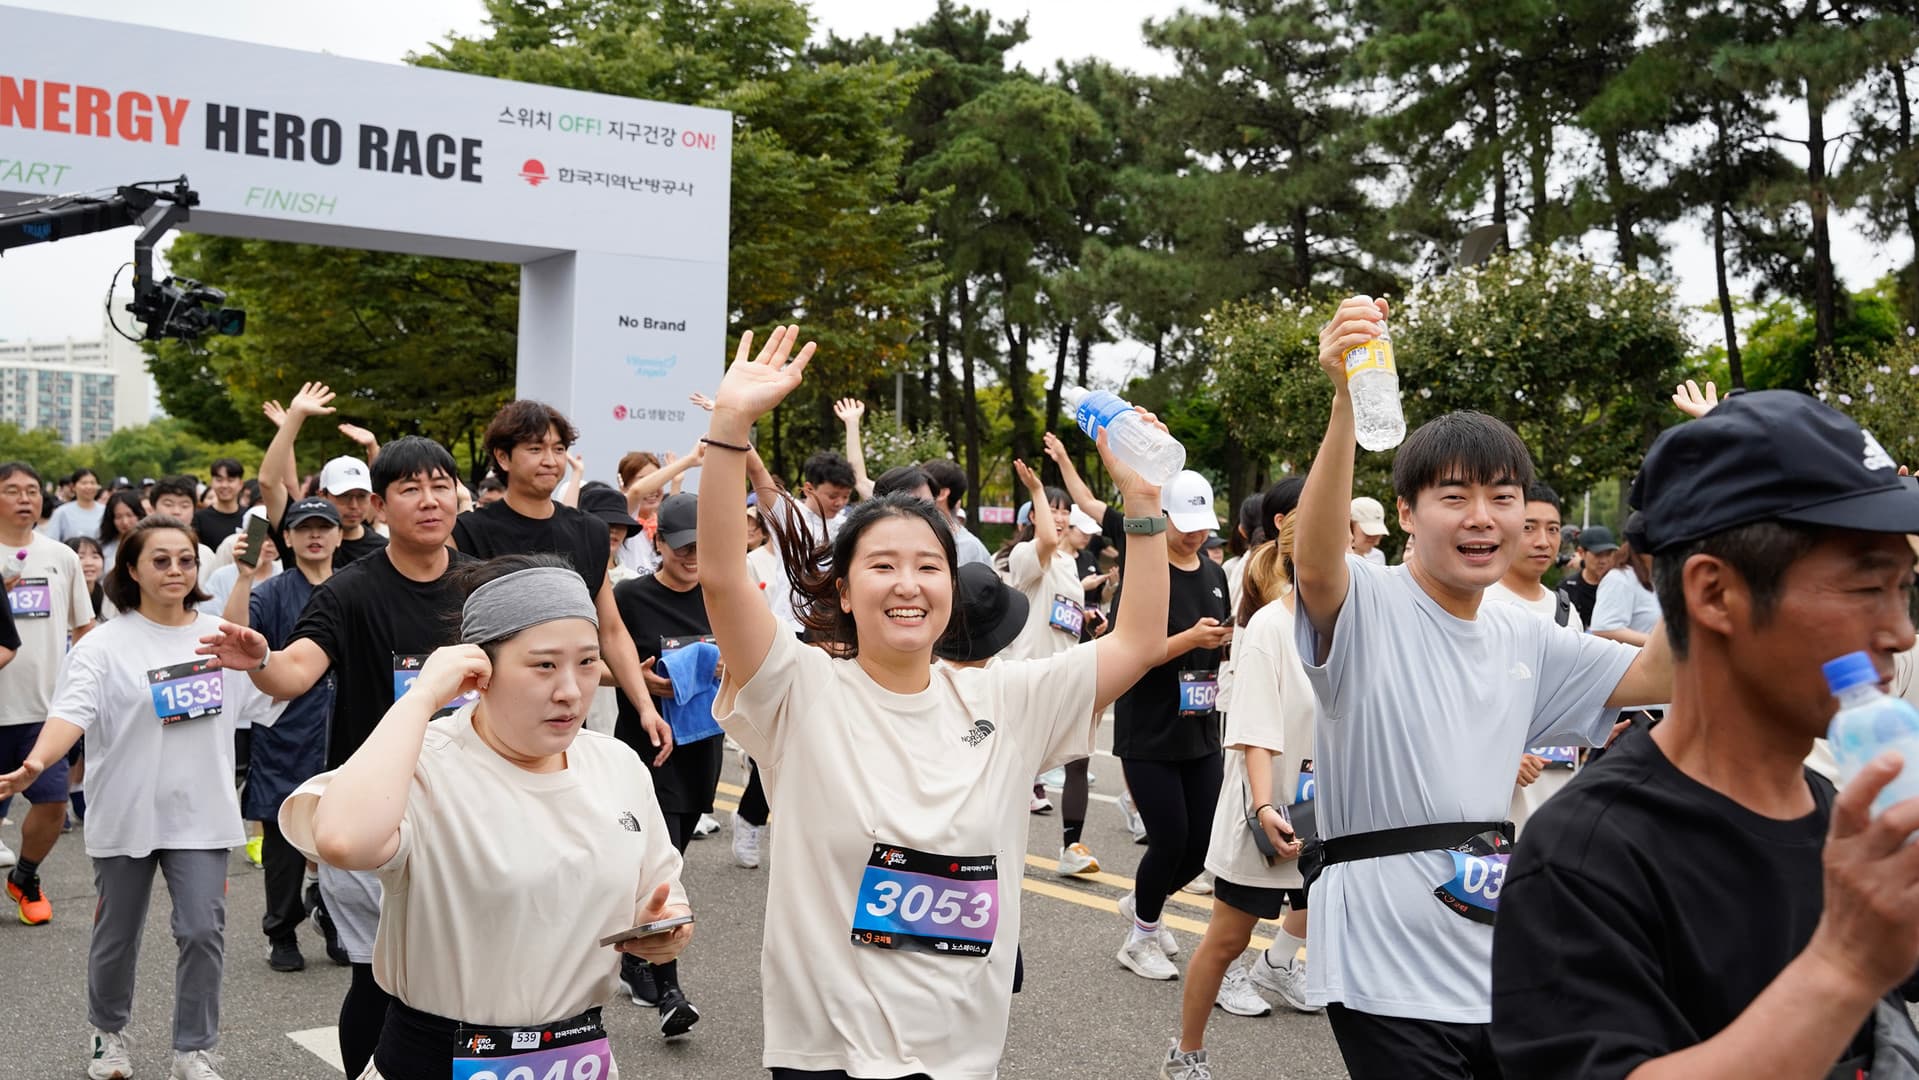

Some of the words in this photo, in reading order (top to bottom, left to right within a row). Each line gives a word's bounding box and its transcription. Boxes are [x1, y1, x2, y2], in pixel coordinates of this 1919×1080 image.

[205, 102, 343, 166] HERO
[358, 123, 483, 184] RACE
[498, 106, 552, 131] 스위치
[558, 114, 602, 136] OFF!
[608, 120, 677, 148] 지구건강
[681, 130, 717, 151] ON!
[558, 167, 694, 197] 한국지역난방공사
[244, 186, 338, 216] FINISH
[618, 315, 639, 328] No
[643, 317, 686, 332] Brand
[630, 408, 646, 420] LG
[161, 677, 222, 710] 1533
[865, 880, 993, 929] 3053
[516, 1032, 537, 1043] 539
